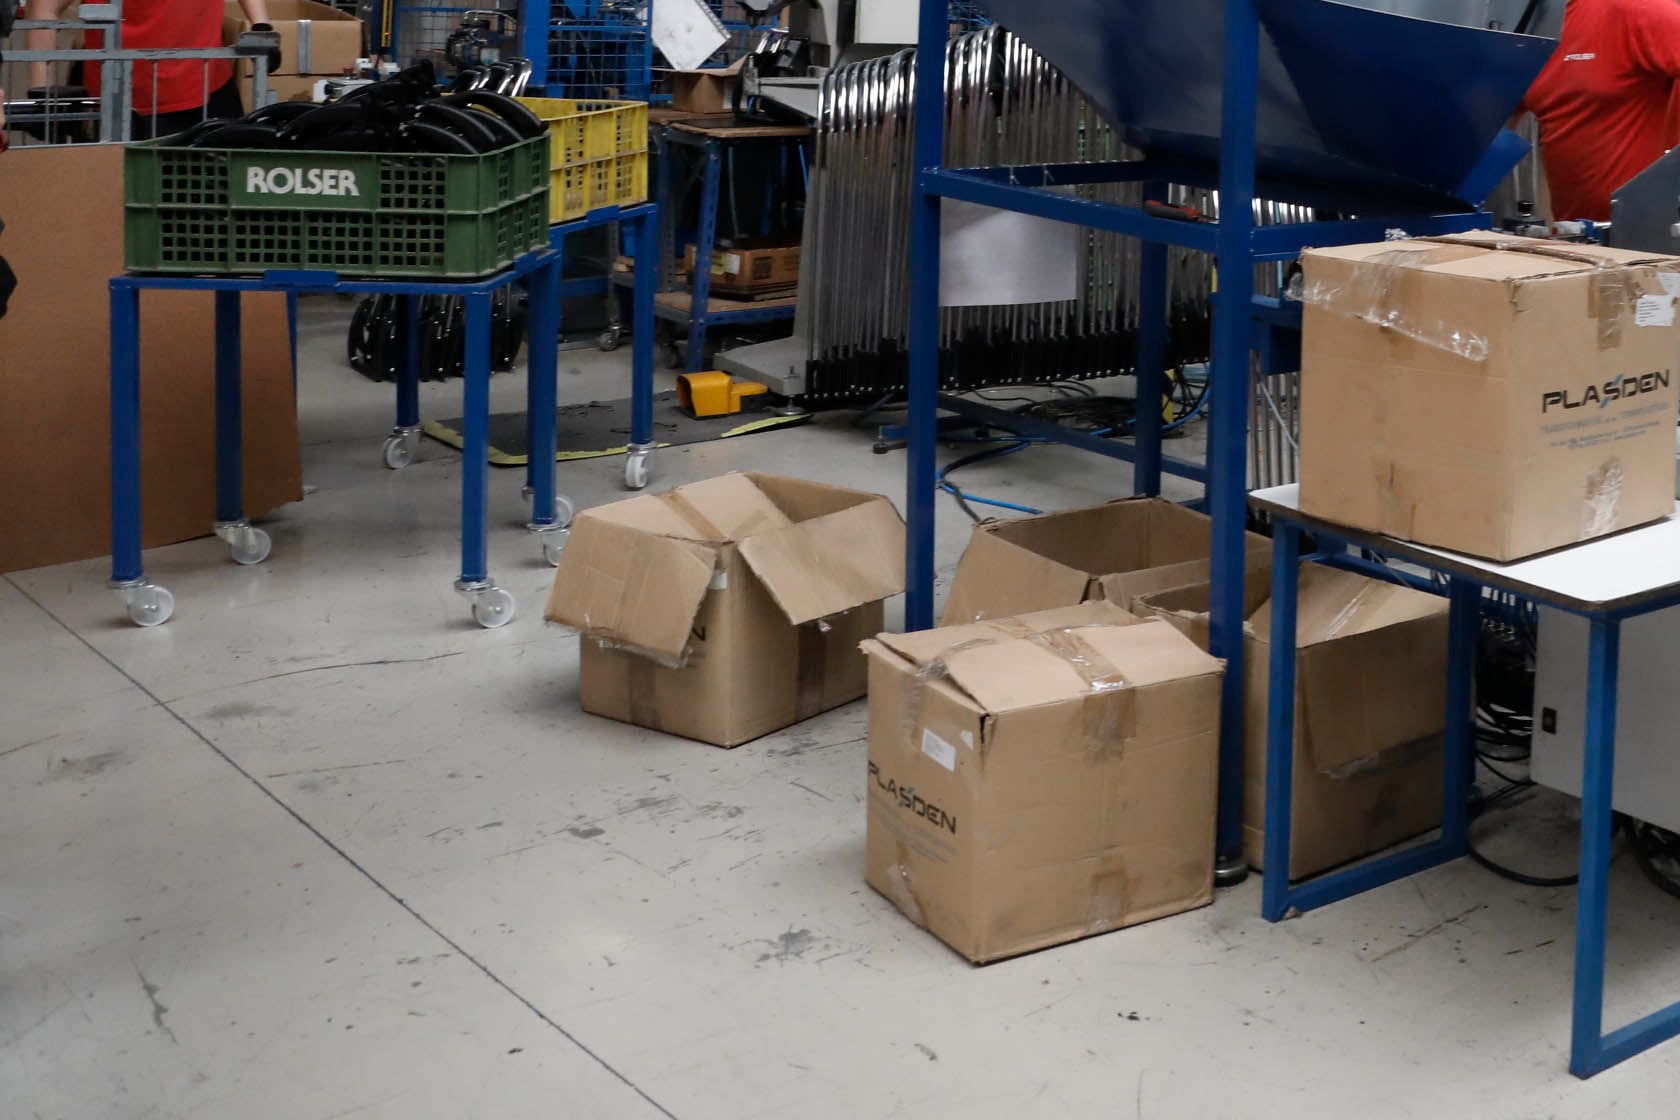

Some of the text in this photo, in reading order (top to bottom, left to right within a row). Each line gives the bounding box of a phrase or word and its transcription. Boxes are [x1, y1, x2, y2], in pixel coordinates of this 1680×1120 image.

[246, 166, 360, 196] ROLSER
[1542, 369, 1670, 414] PLASDEN
[868, 760, 956, 835] PLASDEN
